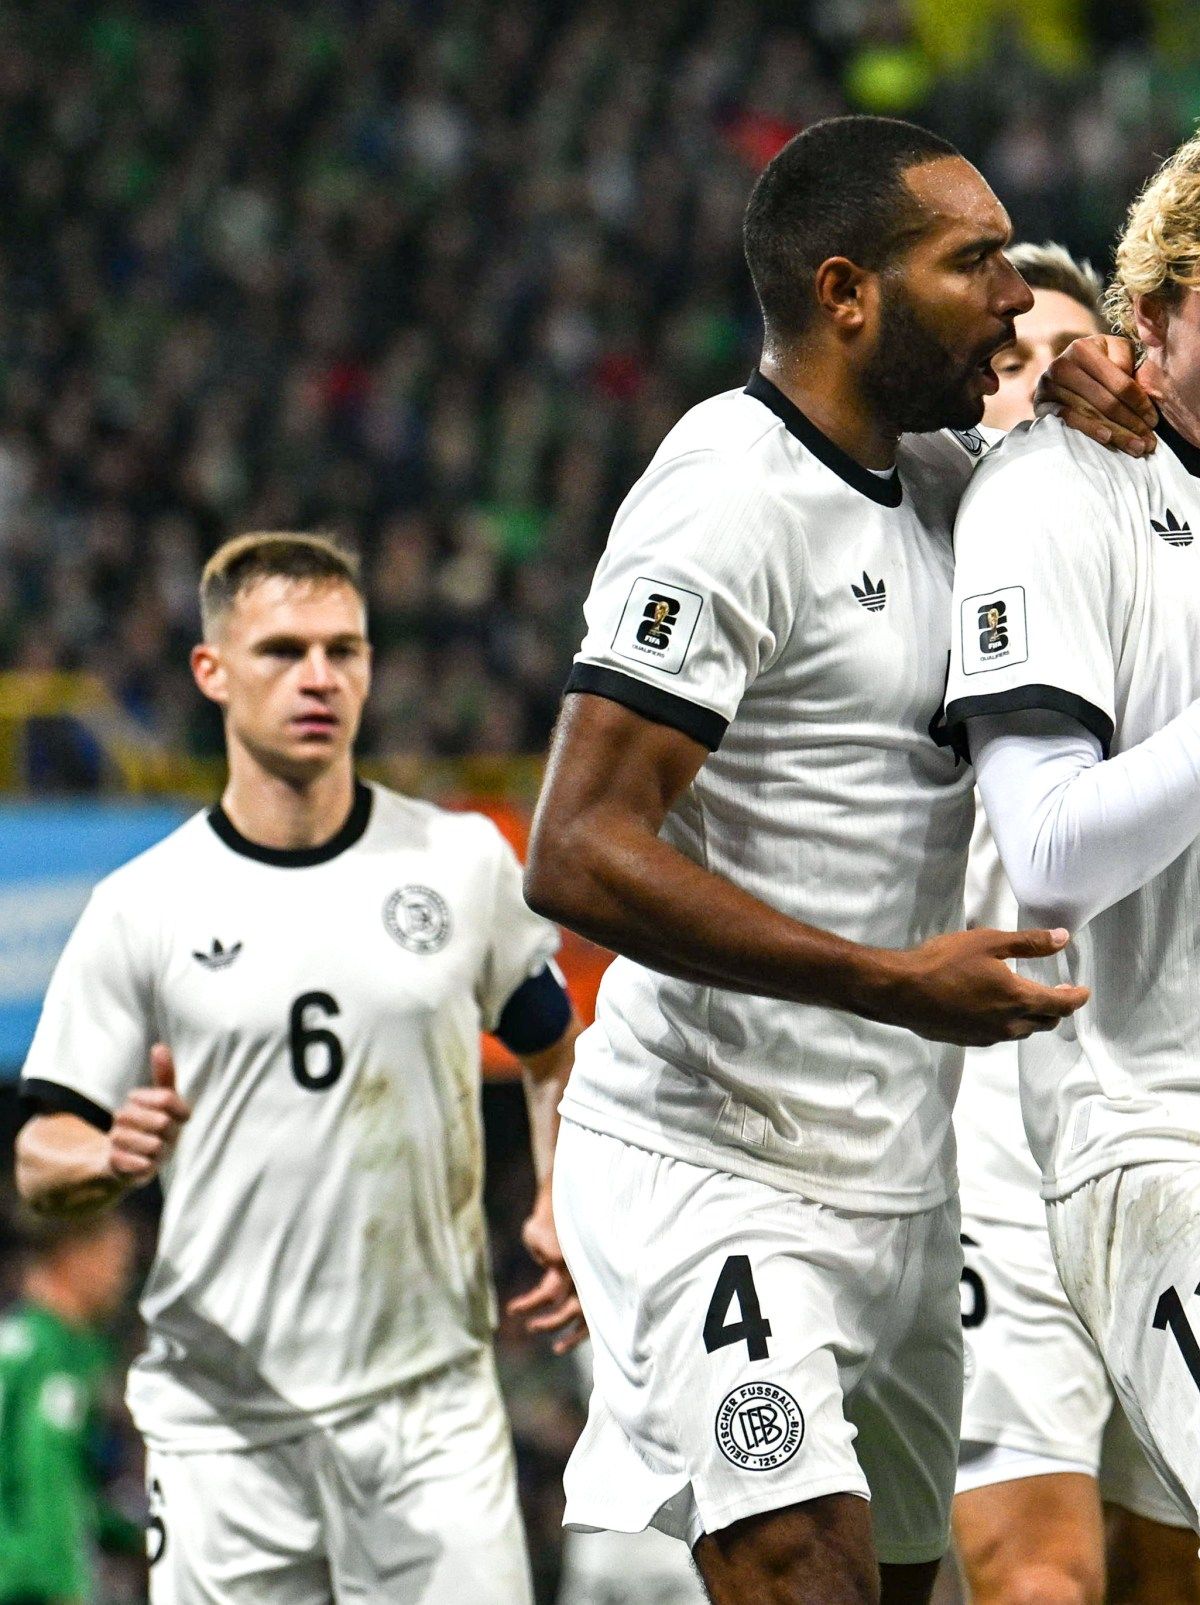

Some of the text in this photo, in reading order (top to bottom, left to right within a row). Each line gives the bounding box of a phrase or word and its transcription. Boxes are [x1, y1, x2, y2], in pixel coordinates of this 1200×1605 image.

[644, 635, 660, 645] FIFA
[632, 644, 665, 658] QUALIFIERS
[980, 650, 1010, 661] QUALIFIERS
[286, 992, 344, 1091] 6
[703, 1255, 772, 1361] 4
[720, 1386, 799, 1464] DEUTSCHER FUSSBALL-BUND
[759, 1455, 777, 1466] 125
